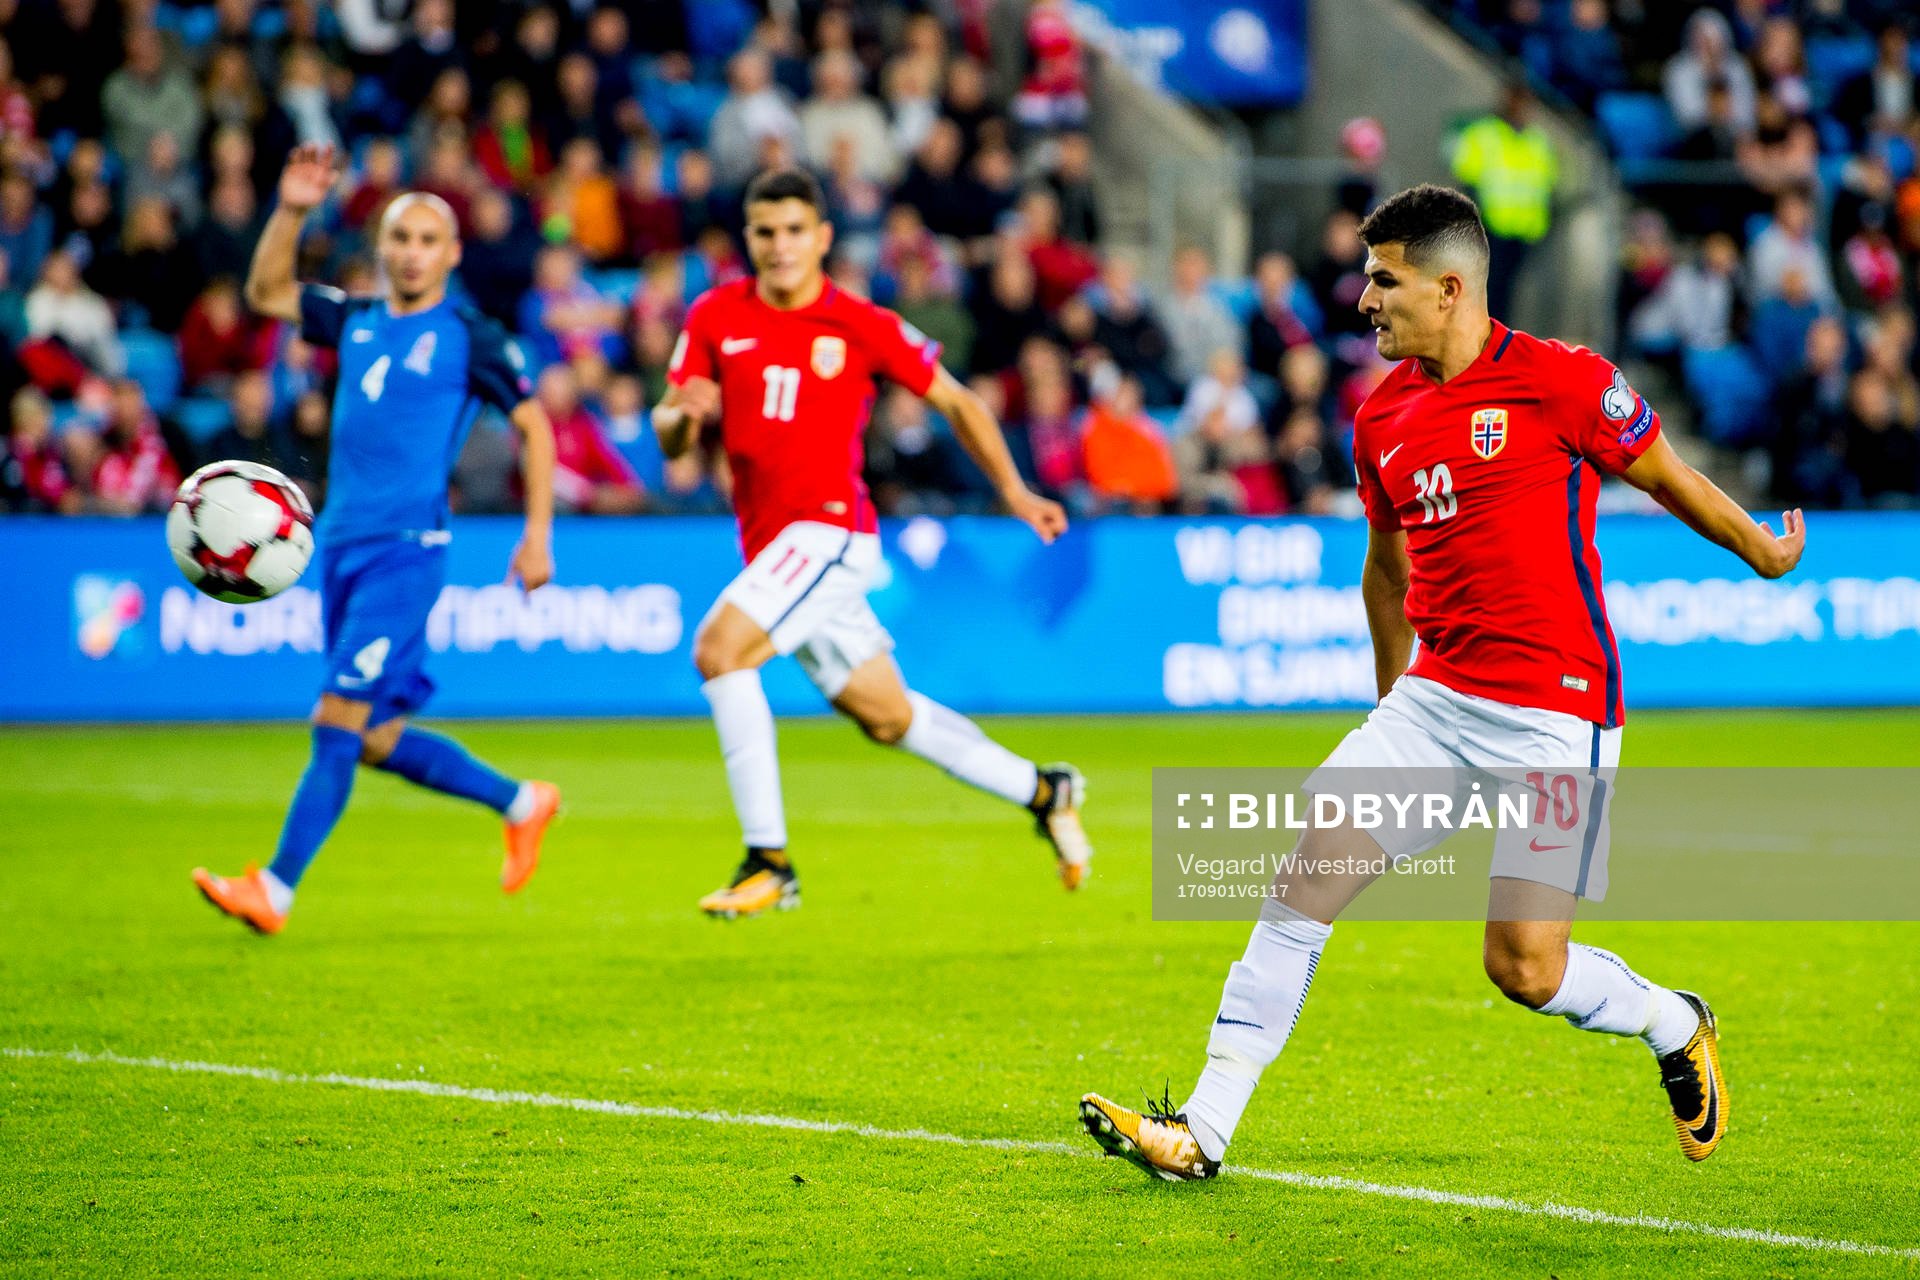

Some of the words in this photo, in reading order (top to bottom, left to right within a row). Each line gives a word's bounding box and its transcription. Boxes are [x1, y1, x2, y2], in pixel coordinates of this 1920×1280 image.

[361, 354, 391, 402] 4
[763, 365, 800, 422] 11
[1413, 463, 1457, 524] 10
[771, 547, 809, 585] 11
[160, 586, 323, 655] NOR
[1825, 577, 1920, 641] TIP
[353, 636, 390, 680] 4
[1526, 771, 1580, 831] 10
